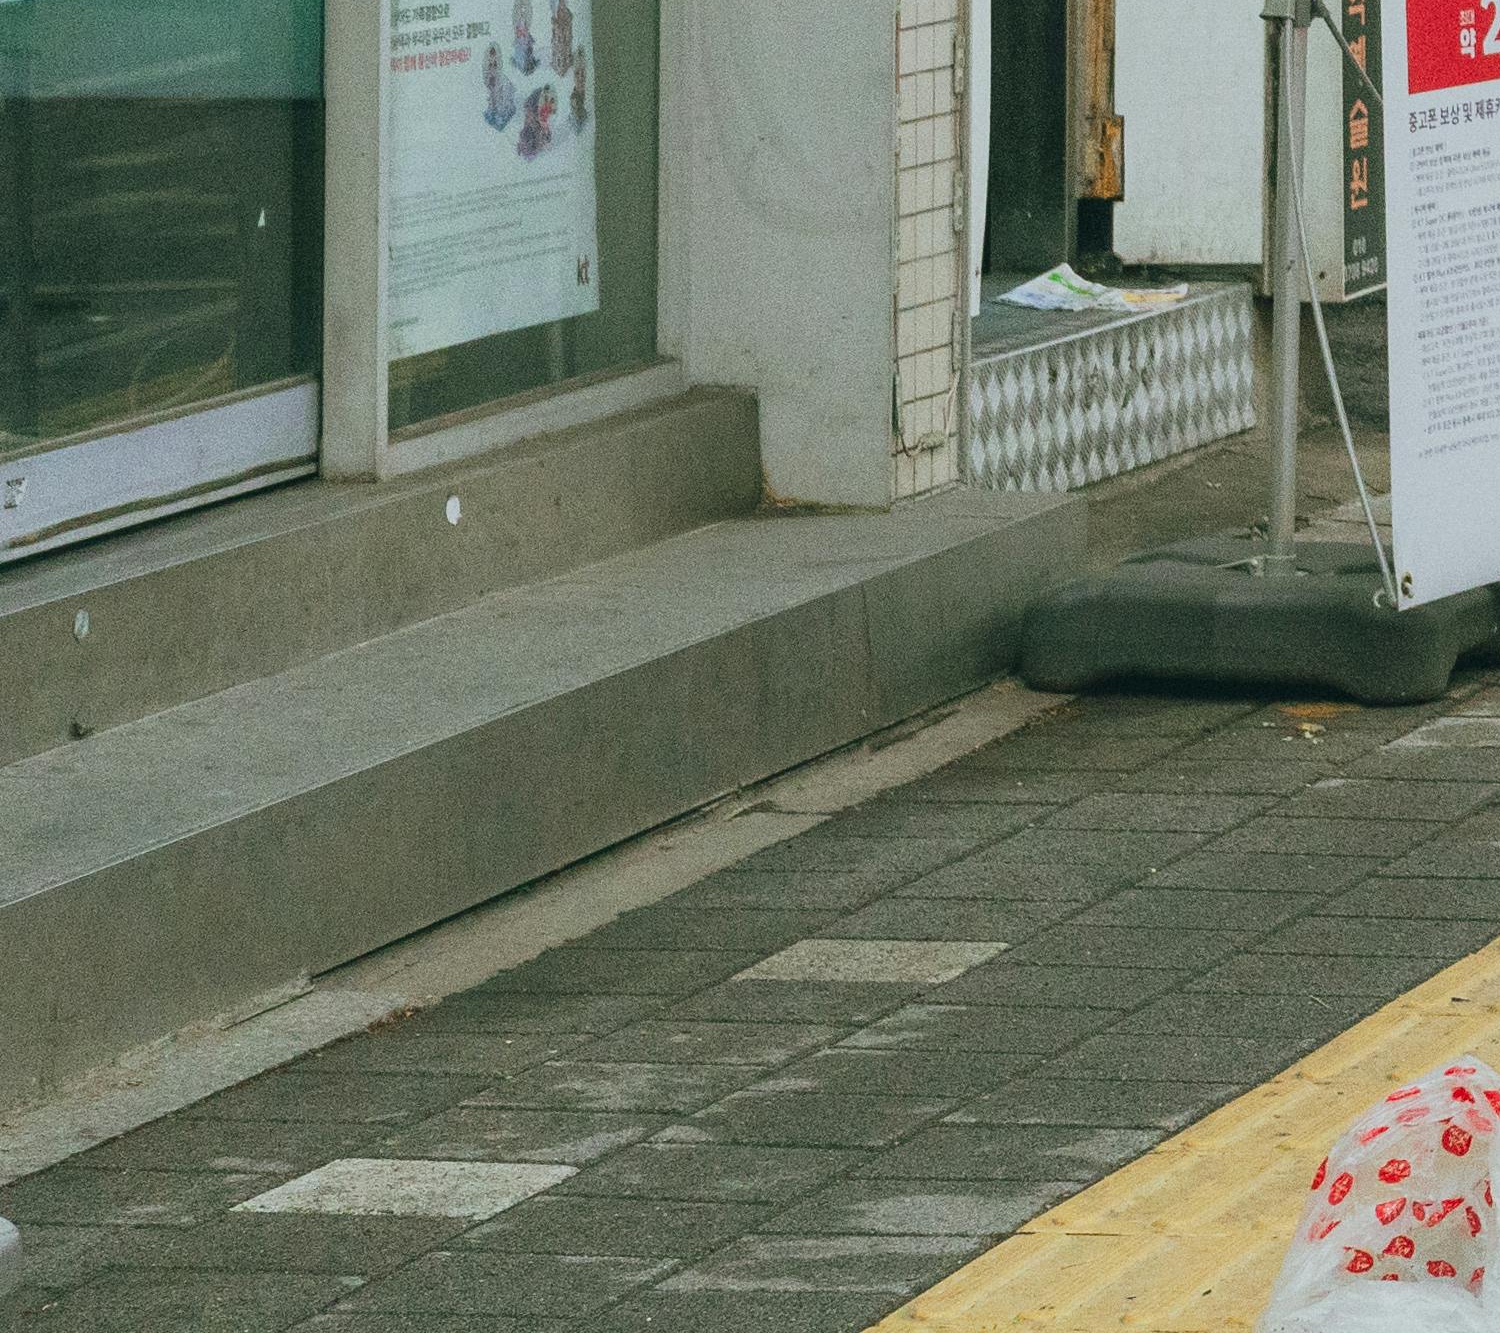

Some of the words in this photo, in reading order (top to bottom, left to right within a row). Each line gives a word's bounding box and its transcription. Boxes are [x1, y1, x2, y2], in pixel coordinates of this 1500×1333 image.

[1459, 27, 1477, 60] 약
[1408, 108, 1438, 134] 중고폰
[1440, 104, 1461, 126] 보상
[1463, 101, 1474, 124] 및
